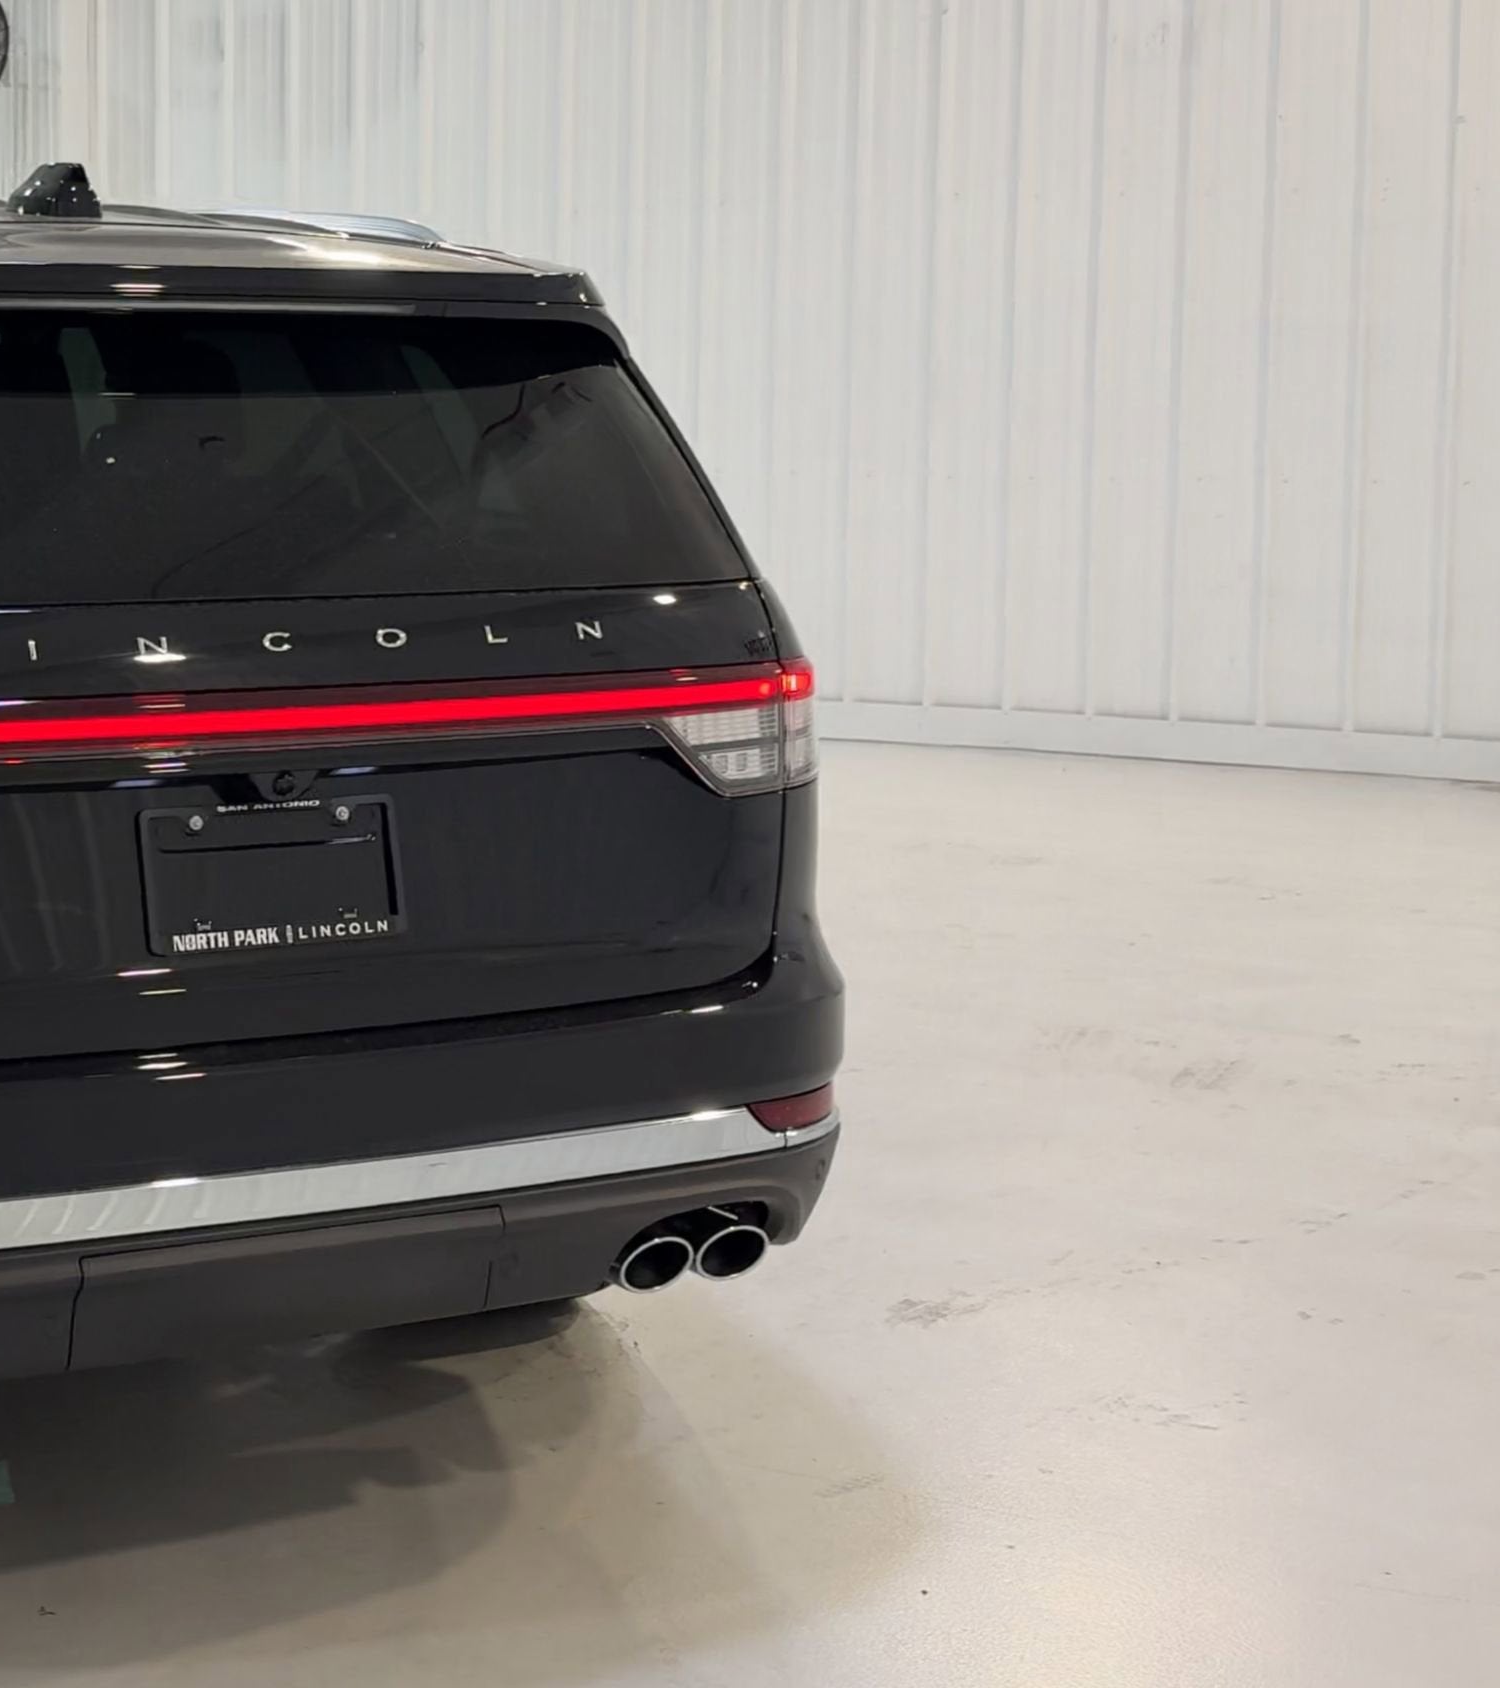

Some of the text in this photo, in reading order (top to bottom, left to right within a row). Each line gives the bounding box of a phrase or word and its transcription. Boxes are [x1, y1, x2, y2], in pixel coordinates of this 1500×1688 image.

[216, 804, 248, 813] SAN
[172, 919, 389, 953] NORTH PARK LINCOLN
